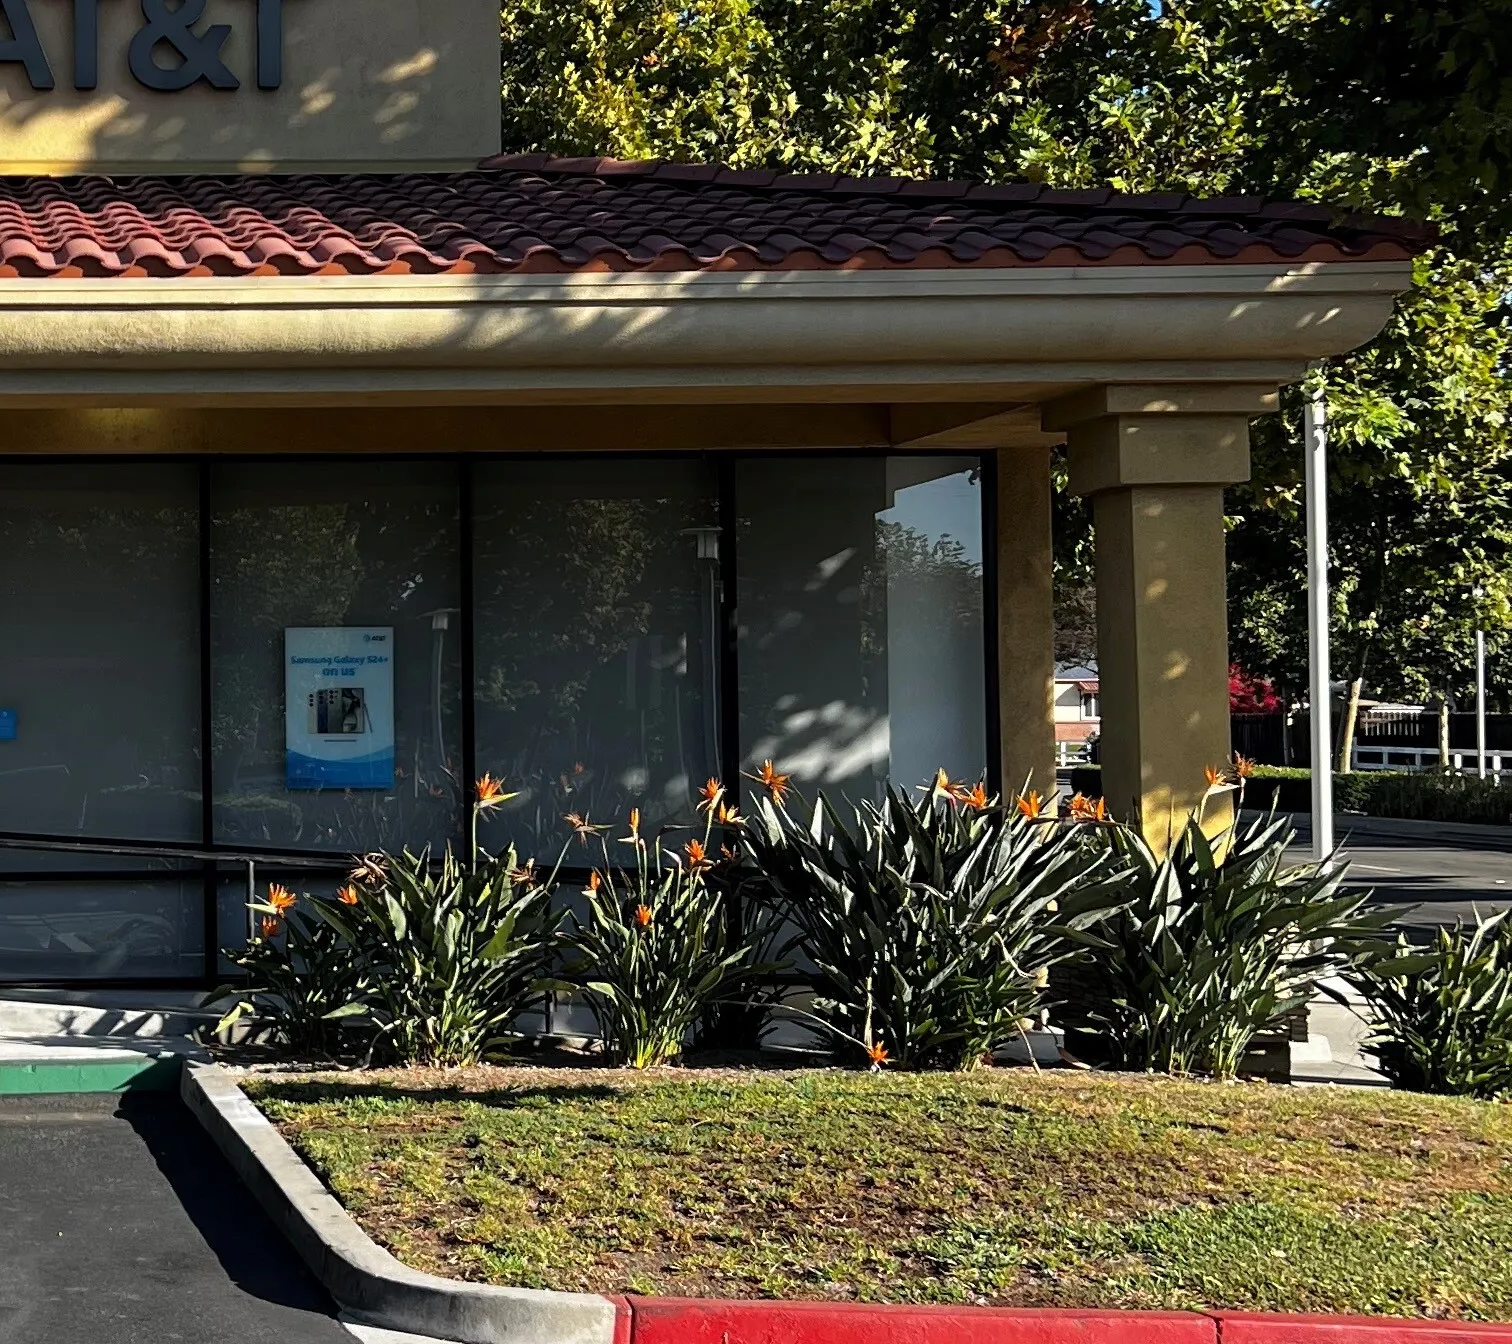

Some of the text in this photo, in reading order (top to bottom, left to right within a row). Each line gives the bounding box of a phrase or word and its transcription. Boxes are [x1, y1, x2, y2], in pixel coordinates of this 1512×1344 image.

[290, 655, 332, 666] Samsung
[334, 655, 365, 666] Galaxy
[322, 667, 356, 676] on us
